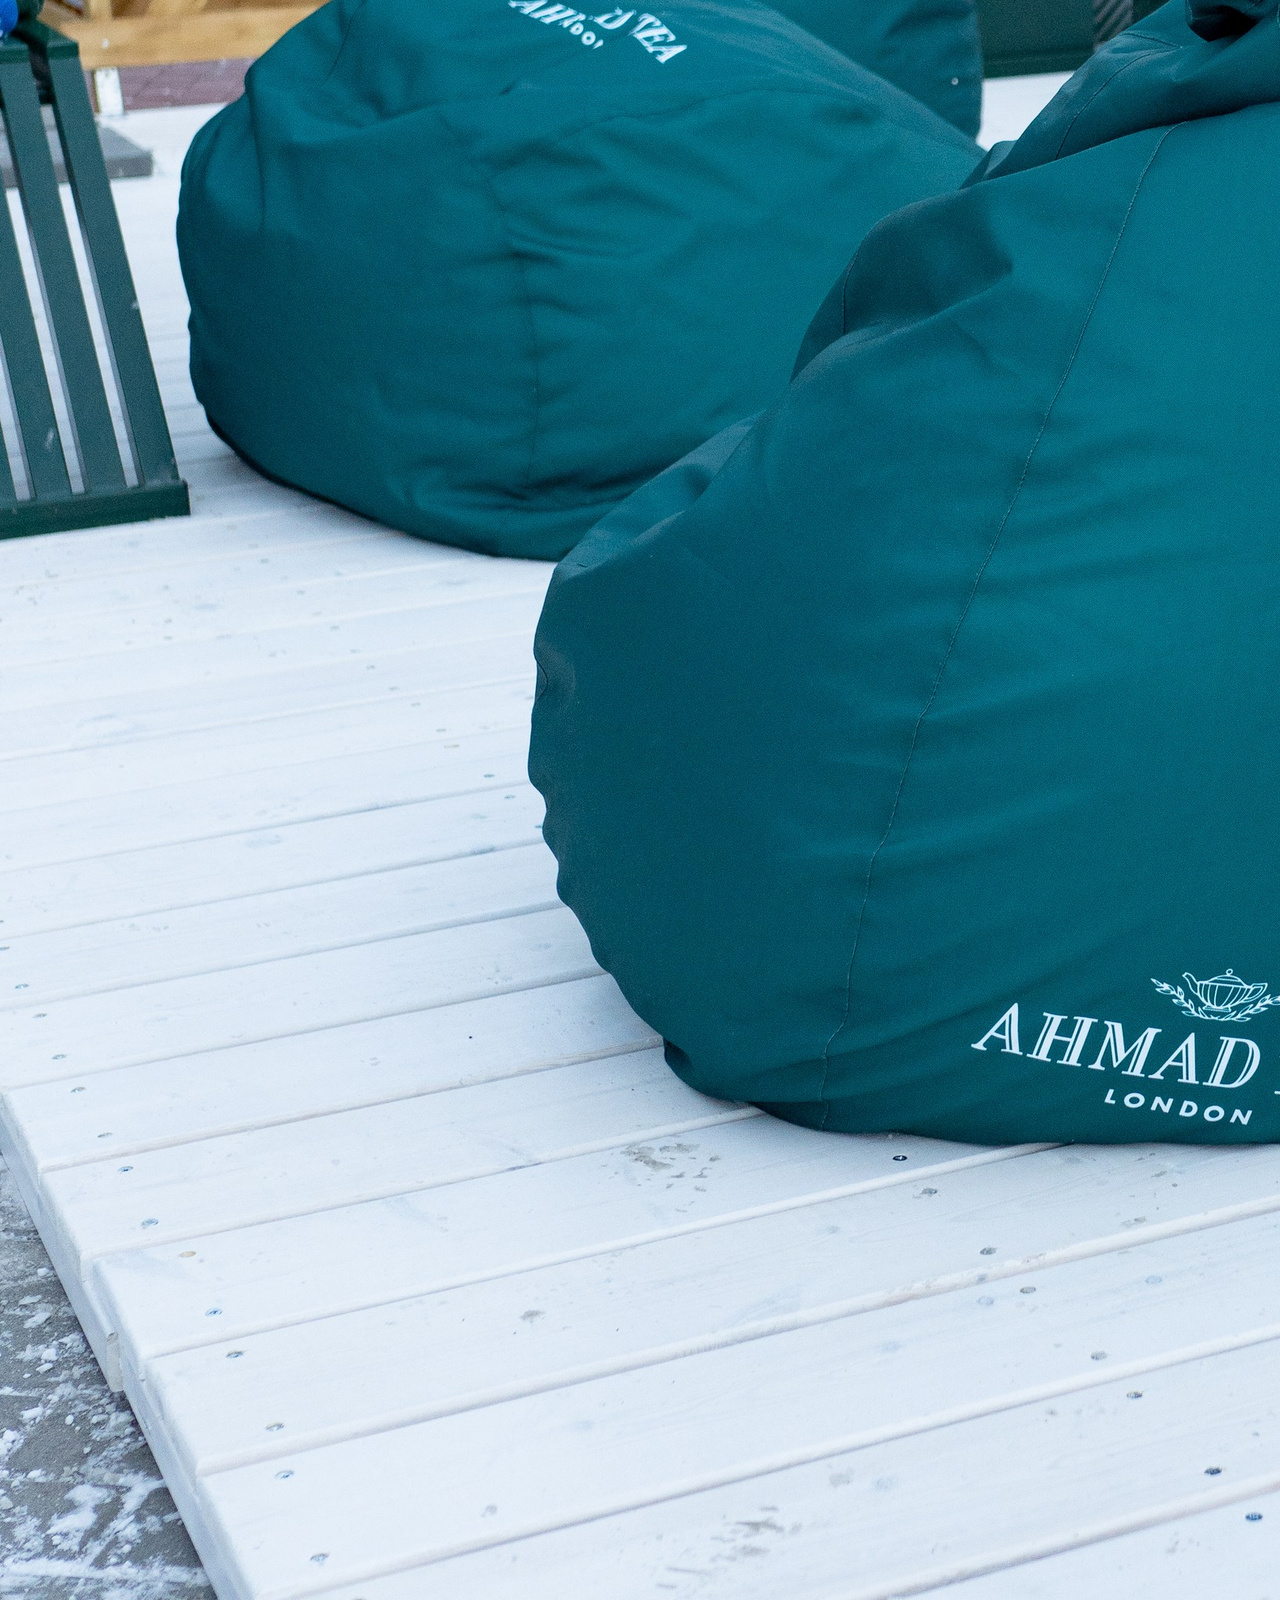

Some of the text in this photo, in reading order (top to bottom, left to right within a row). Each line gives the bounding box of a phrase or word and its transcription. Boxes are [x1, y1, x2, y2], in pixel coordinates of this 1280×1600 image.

[627, 12, 688, 64] TEA
[970, 1002, 1261, 1090] AHMAD
[1104, 1088, 1253, 1126] LONDON
